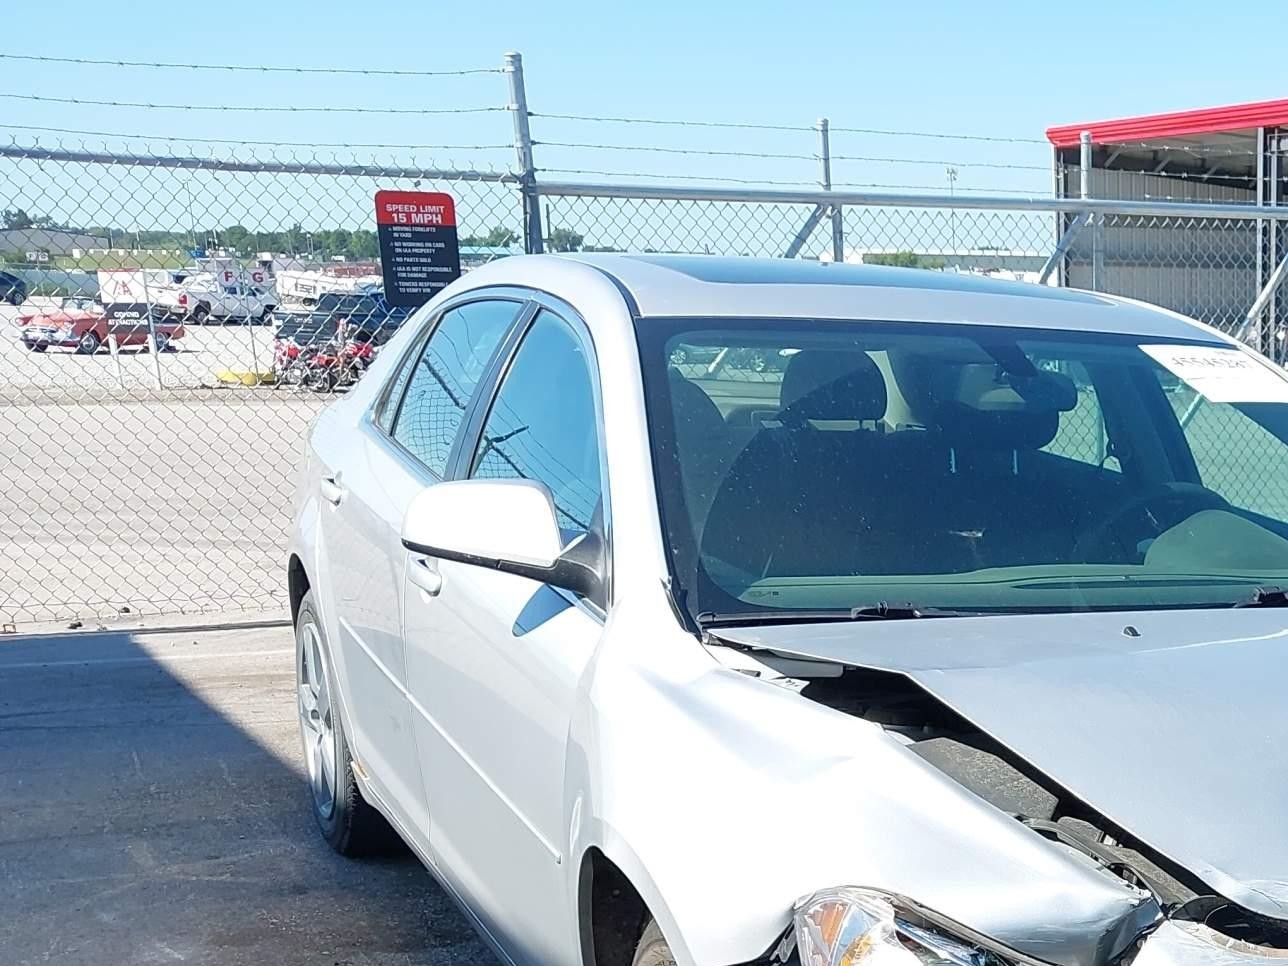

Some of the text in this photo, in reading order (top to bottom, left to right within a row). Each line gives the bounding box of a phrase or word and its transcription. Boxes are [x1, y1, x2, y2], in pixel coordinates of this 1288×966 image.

[386, 204, 445, 213] SPEED LIMIT
[392, 213, 442, 224] 15 MPH
[224, 271, 233, 281] F
[252, 272, 263, 282] G
